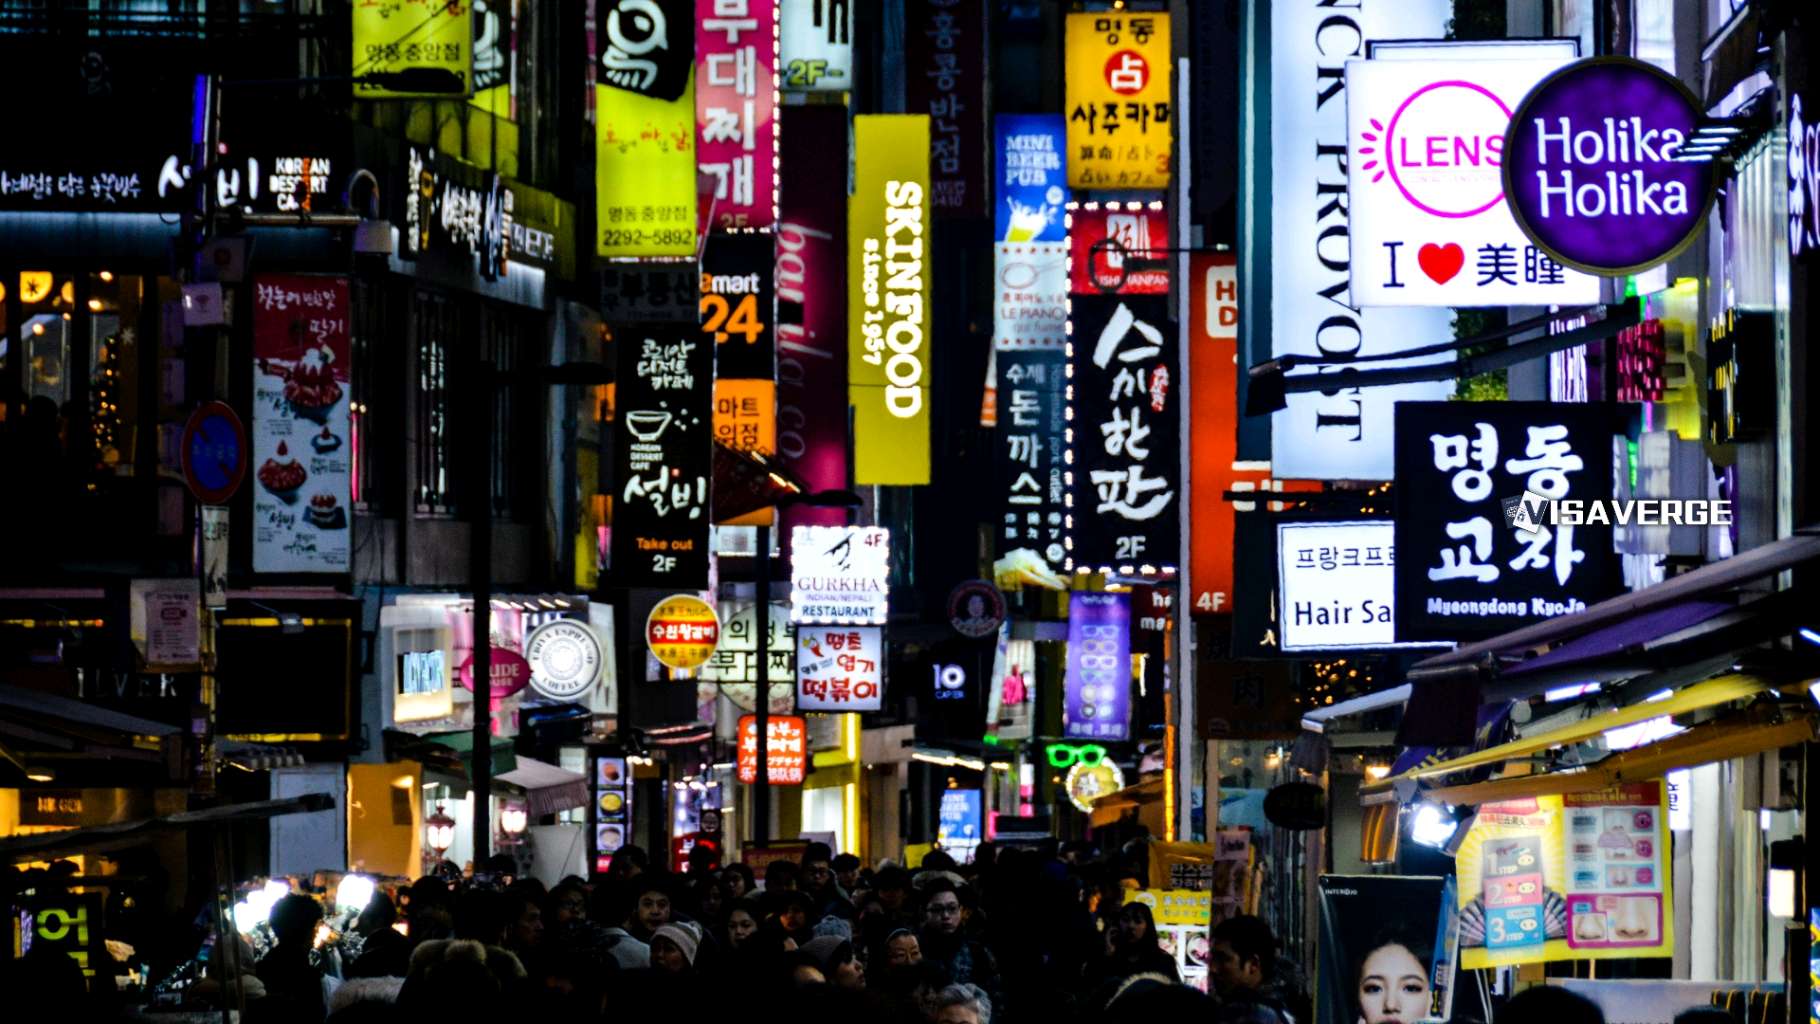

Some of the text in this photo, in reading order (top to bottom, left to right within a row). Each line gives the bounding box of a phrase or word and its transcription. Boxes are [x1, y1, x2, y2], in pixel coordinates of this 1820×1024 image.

[1095, 19, 1155, 45] 명동
[1110, 55, 1143, 90] 占
[1400, 133, 1506, 167] LENS
[1534, 116, 1686, 165] Holika
[1005, 151, 1061, 169] BEER
[1005, 169, 1047, 187] PUB
[1536, 169, 1689, 219] Holika
[603, 228, 692, 247] 2292-5892
[1382, 241, 1405, 288] I
[1476, 243, 1565, 287] 美瞳
[699, 272, 760, 295] emart
[884, 180, 923, 419] SKINFOOD
[699, 294, 765, 344] 24
[1020, 306, 1067, 321] PIANO
[310, 318, 344, 344] 딸기
[862, 311, 887, 366] 1957
[640, 338, 697, 359] 코리안
[636, 358, 690, 377] 디저트
[1005, 363, 1046, 385] 수제
[650, 374, 694, 391] 카페
[1006, 388, 1045, 504] 돈까스
[1429, 422, 1584, 502] 명동
[636, 537, 694, 551] Take out
[863, 533, 883, 548] 4F
[1114, 535, 1147, 560] 2F
[1427, 515, 1585, 587] 교자
[652, 554, 677, 573] 2F
[797, 576, 880, 592] GURKHA
[802, 605, 876, 618] RESTAURANT
[1196, 592, 1226, 612] 4F
[1294, 600, 1353, 627] Hair
[1427, 598, 1528, 617] Myeongdong
[652, 623, 716, 641] 수원왕갈비
[825, 632, 862, 651] 땡초
[836, 653, 876, 673] 엽기
[801, 677, 879, 703] 떡볶이
[1490, 915, 1506, 943] 3
